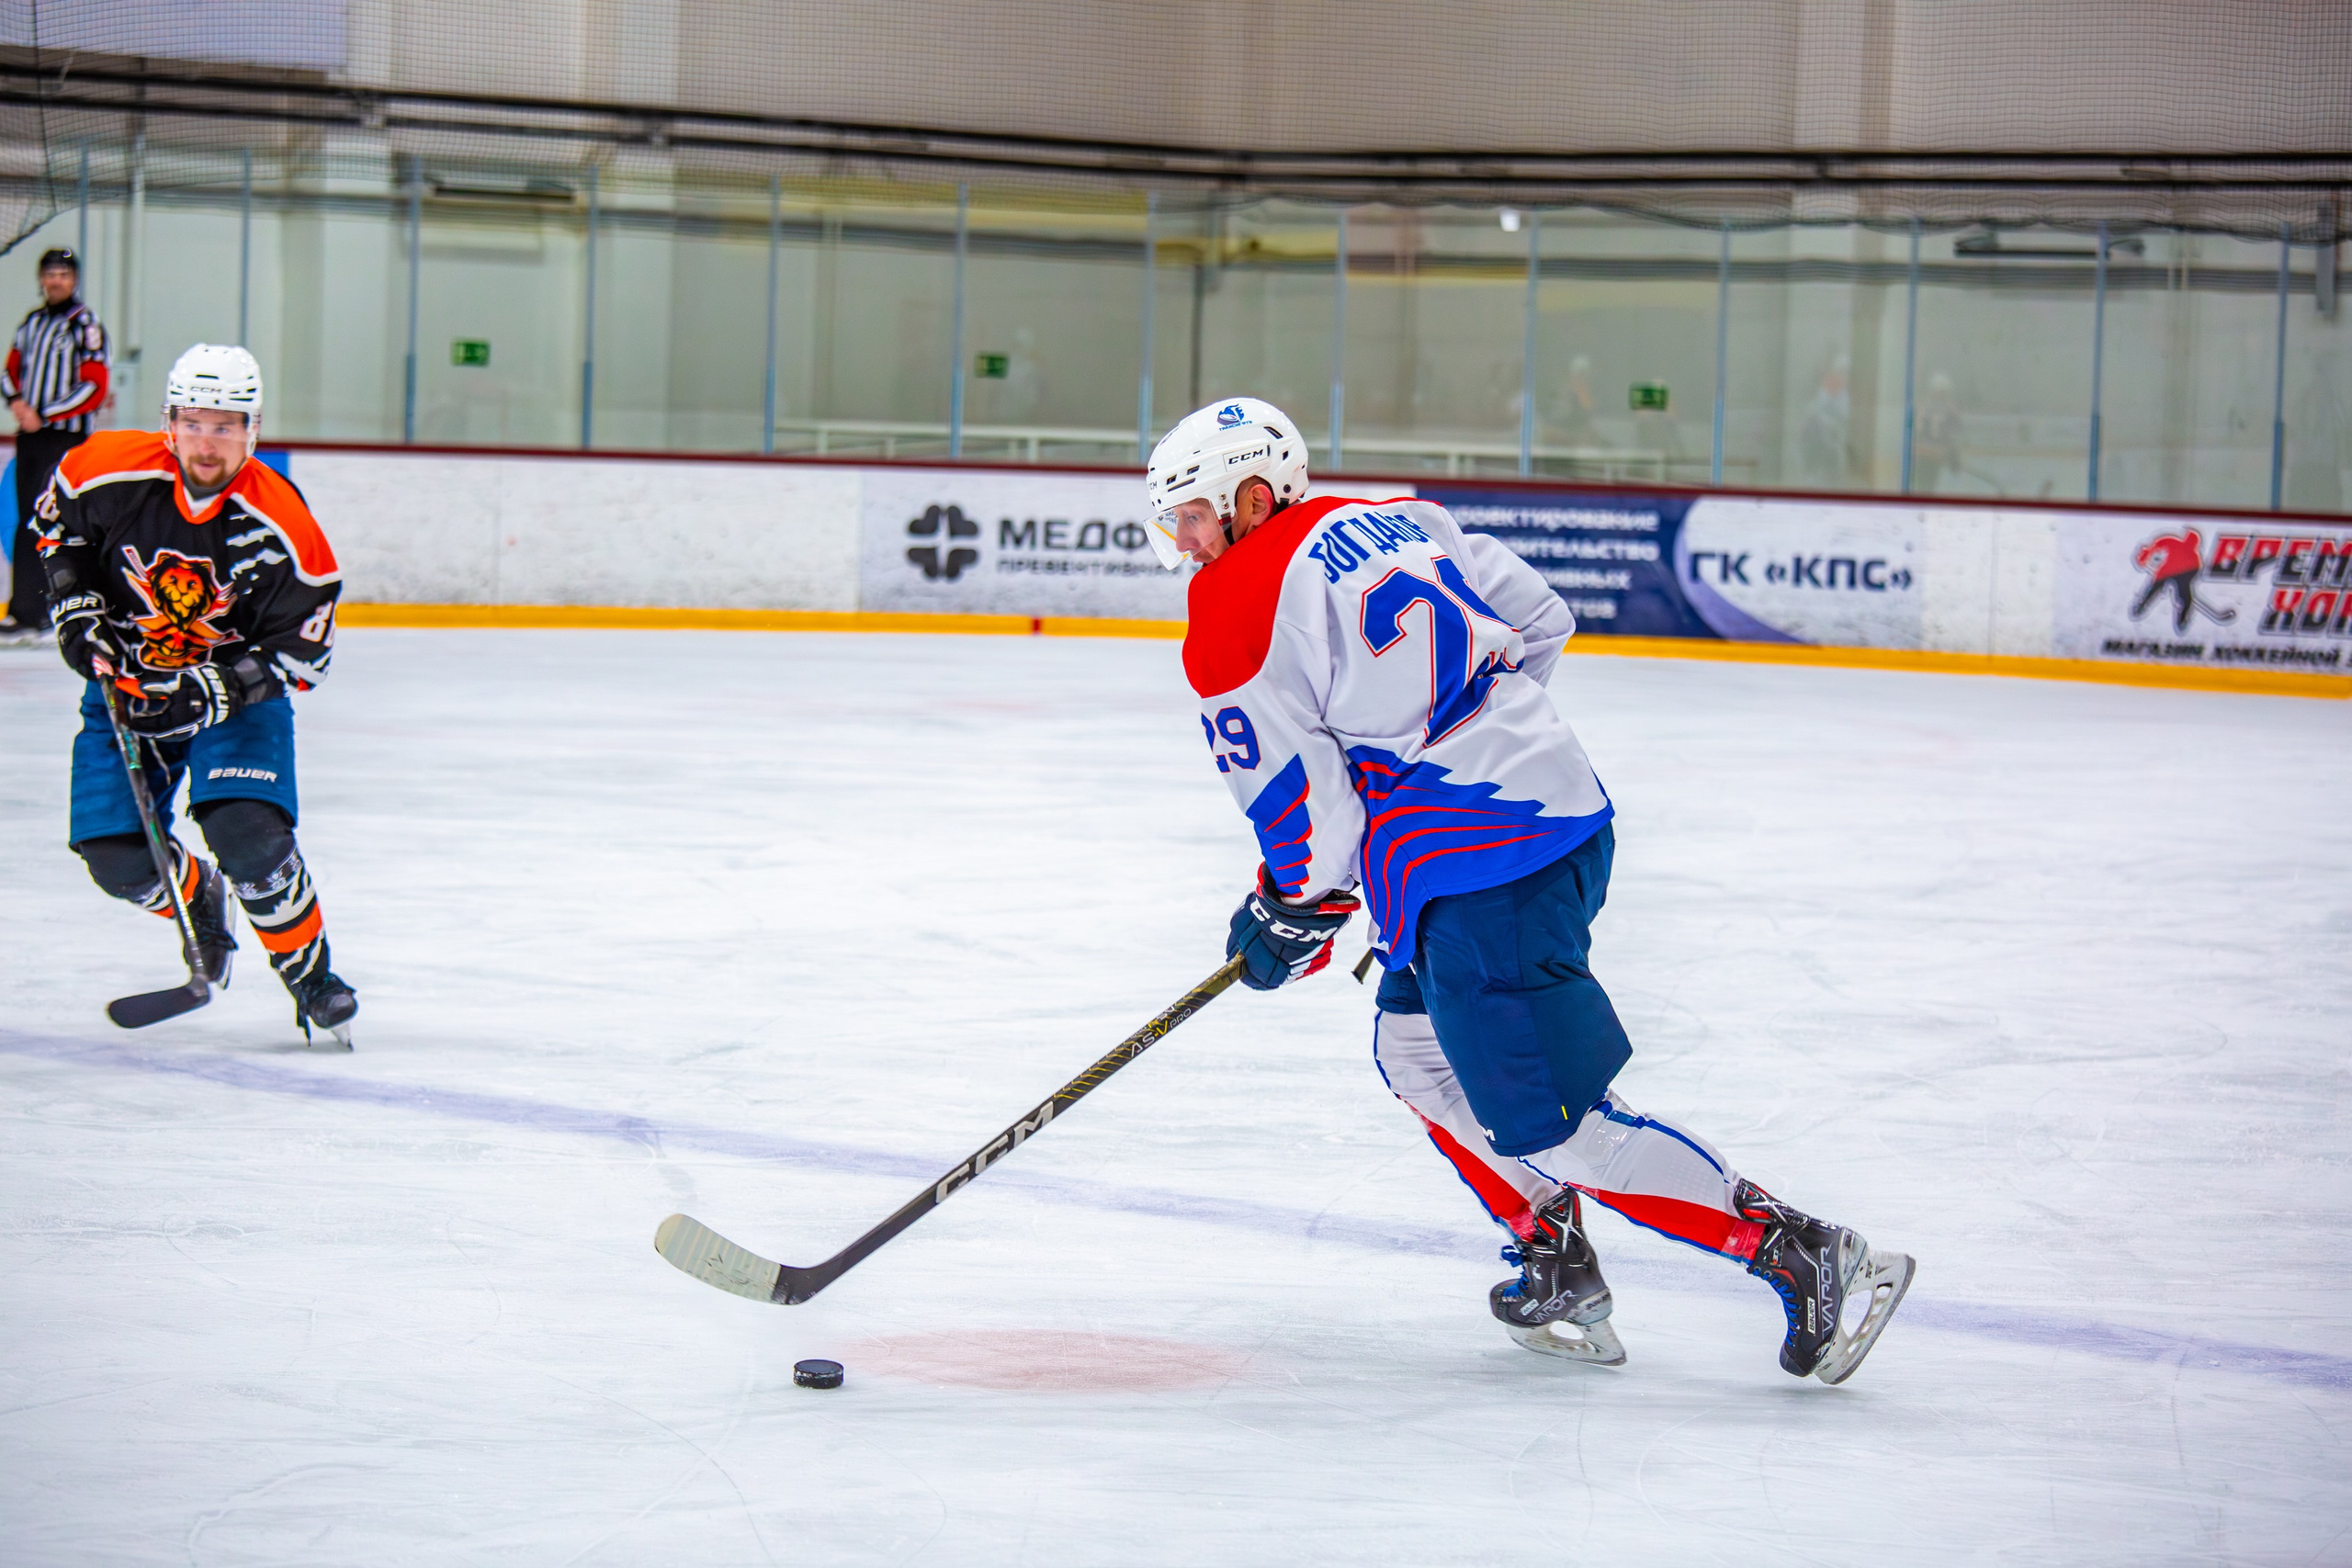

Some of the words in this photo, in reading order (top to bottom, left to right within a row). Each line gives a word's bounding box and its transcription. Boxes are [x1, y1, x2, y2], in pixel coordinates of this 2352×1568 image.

[1227, 448, 1264, 465] CCM
[999, 518, 1148, 552] МЕДФ
[1690, 552, 1751, 586] ГК
[1765, 556, 1913, 593] «КПС»
[2207, 535, 2352, 585] ВРЕМ
[1250, 897, 1339, 942] CCM
[1169, 1008, 1192, 1029] PRO
[935, 1100, 1054, 1203] CCM
[1530, 1289, 1580, 1324] VAPOR
[1819, 1244, 1836, 1332] VAPOR
